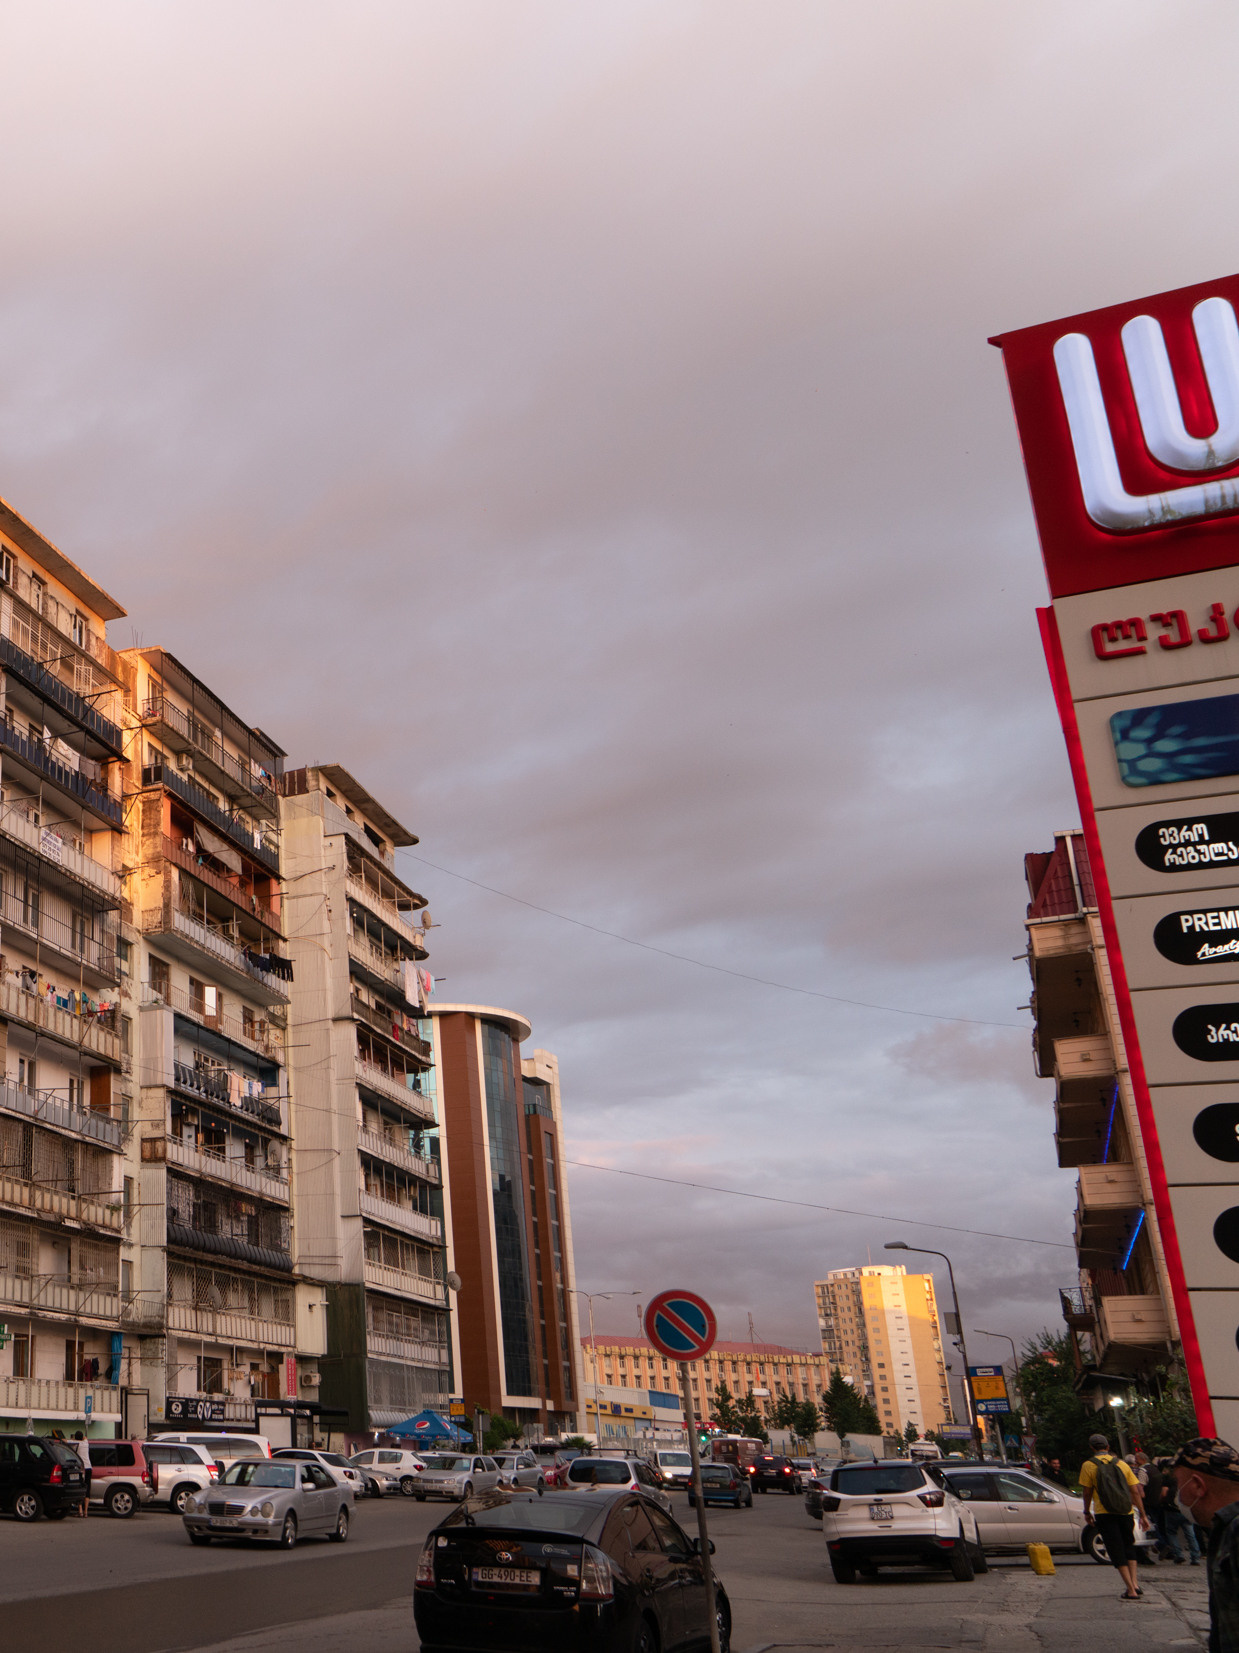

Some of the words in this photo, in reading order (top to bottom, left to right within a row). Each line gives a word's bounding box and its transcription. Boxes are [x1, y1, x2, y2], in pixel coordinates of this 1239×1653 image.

[1091, 602, 1239, 660] ლუკ
[1158, 822, 1210, 846] ევრო
[1164, 841, 1239, 867] რეგულა
[480, 1568, 533, 1584] GG-490-EE
